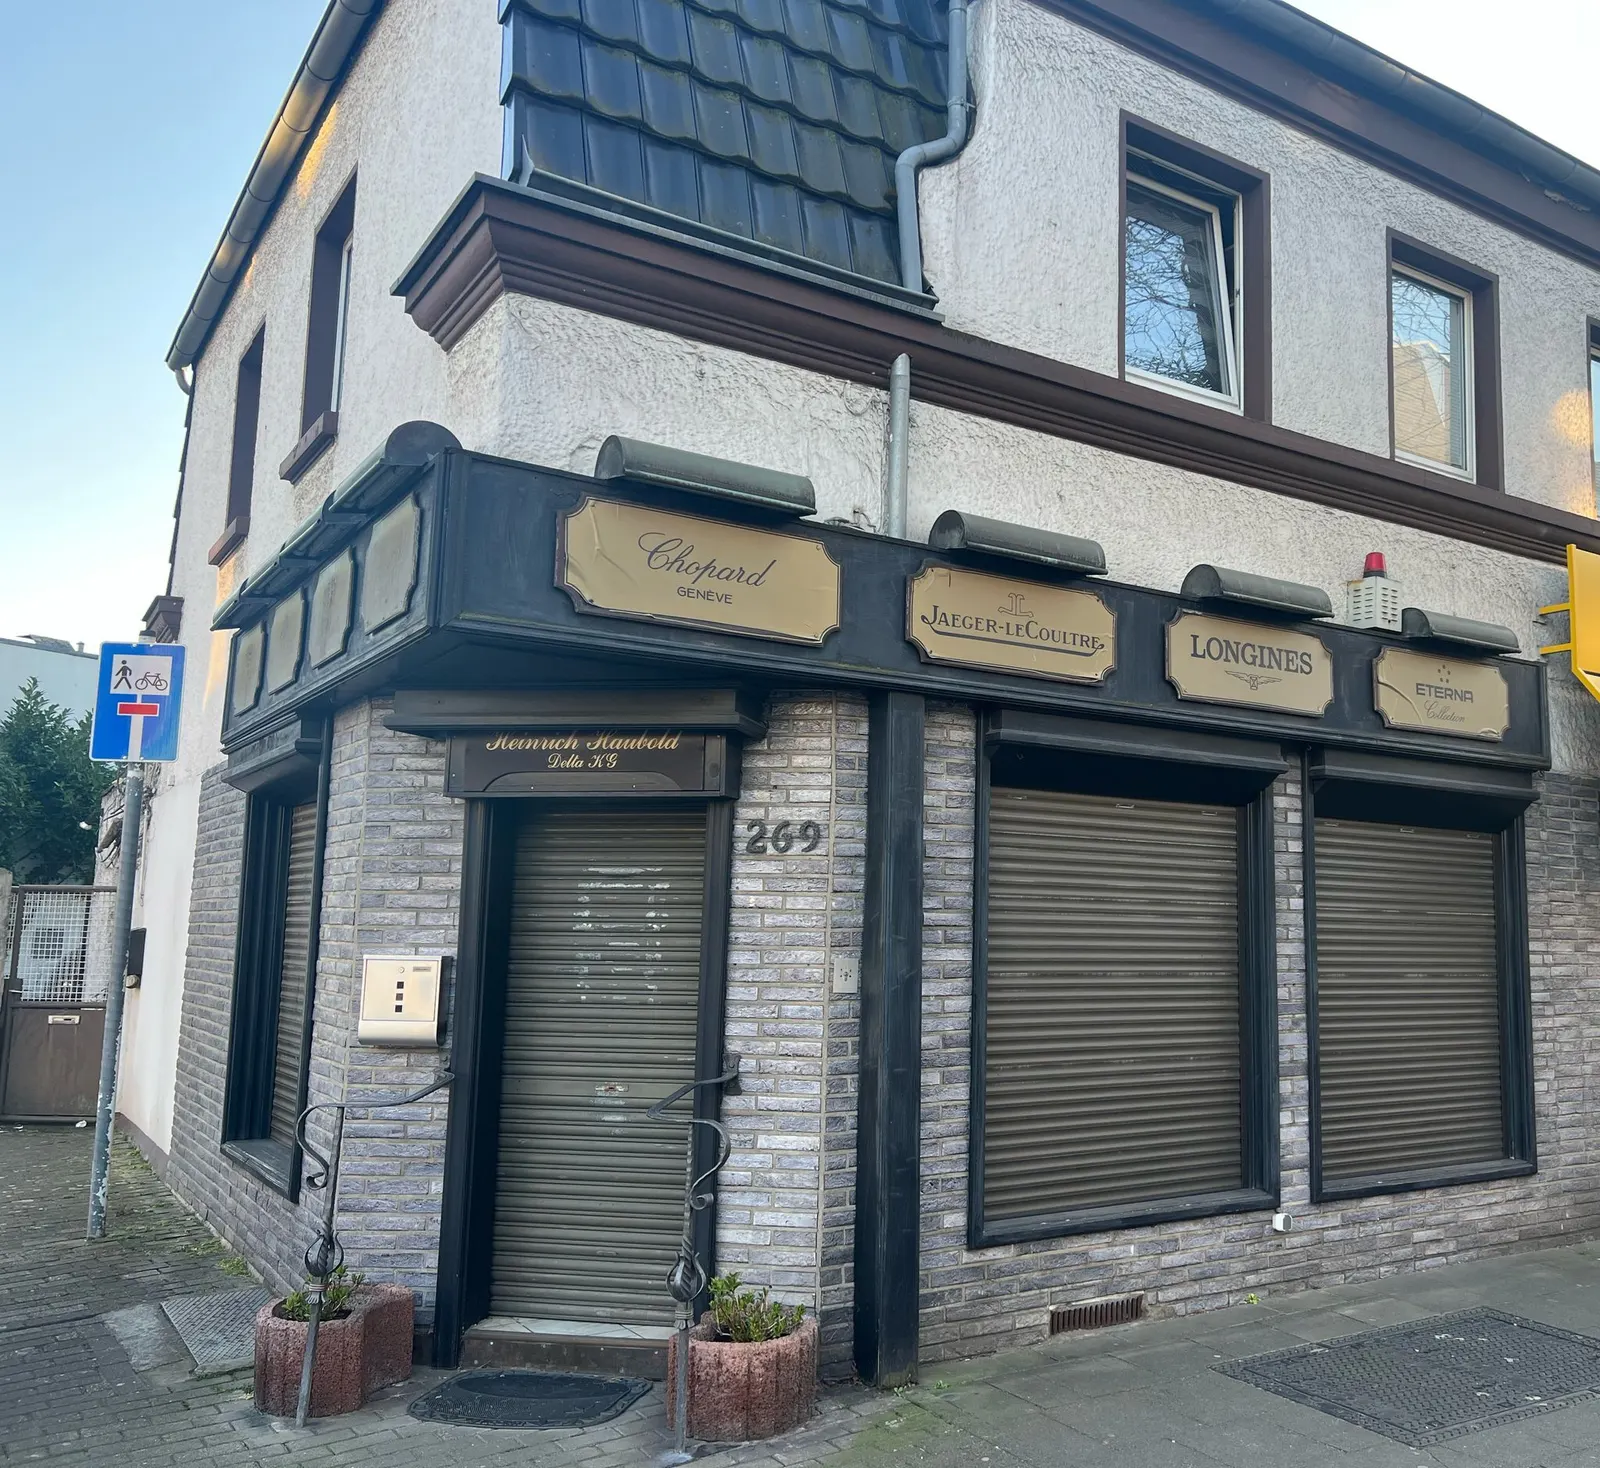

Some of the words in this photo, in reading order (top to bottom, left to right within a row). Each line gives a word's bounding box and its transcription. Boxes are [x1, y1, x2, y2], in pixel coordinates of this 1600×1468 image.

[638, 532, 777, 587] Chopard
[677, 586, 733, 605] GENÈVE
[1190, 634, 1313, 675] LONGINES
[1416, 682, 1473, 704] ETERNA
[486, 730, 580, 751] Heinrich
[547, 752, 585, 769] Delta
[587, 752, 619, 769] KG
[746, 819, 821, 853] 269
